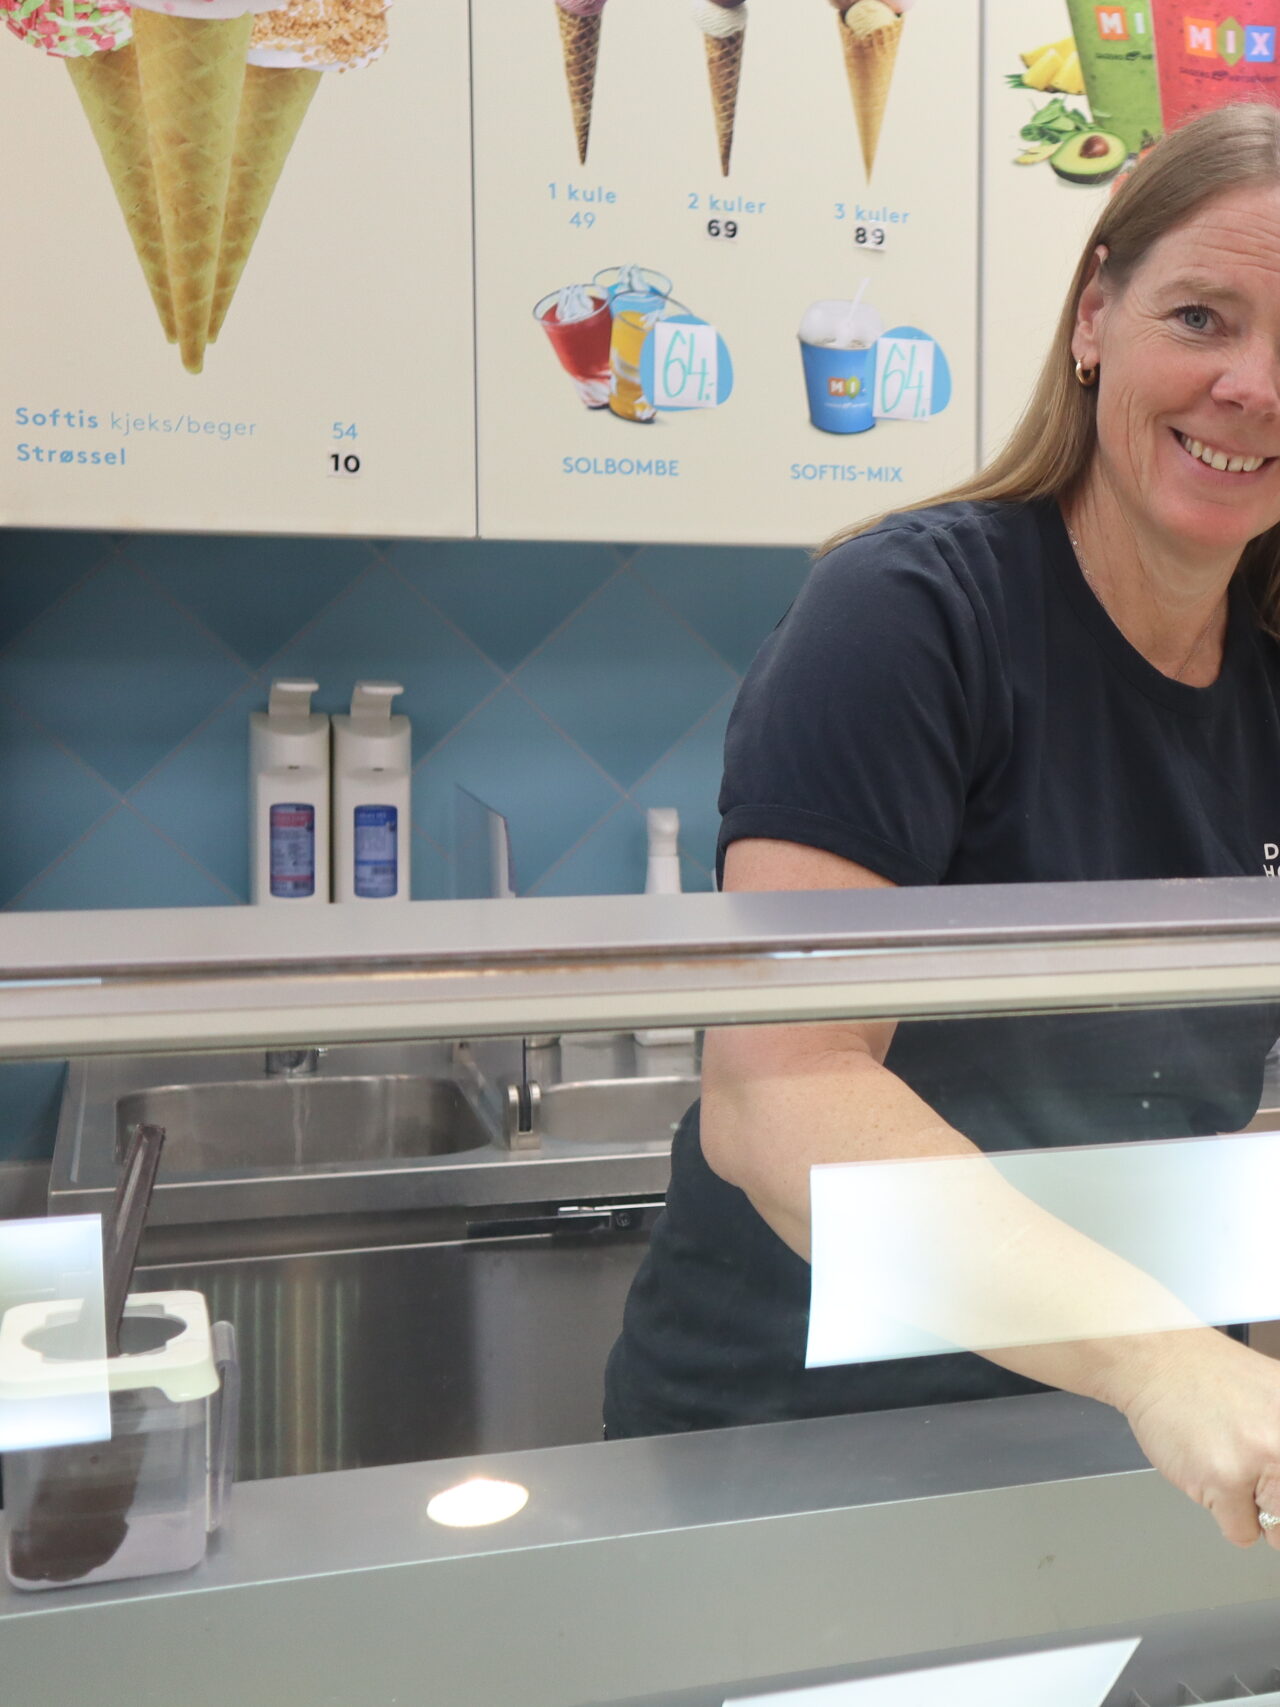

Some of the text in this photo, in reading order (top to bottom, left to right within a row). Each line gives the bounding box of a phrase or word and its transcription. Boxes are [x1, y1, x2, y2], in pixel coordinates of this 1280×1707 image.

[1099, 12, 1146, 34] MI
[1188, 25, 1270, 56] MIX
[548, 182, 618, 205] 1 kule
[688, 193, 767, 215] 2 kuler
[569, 211, 596, 230] 49
[834, 203, 910, 224] 3 kuler
[707, 219, 738, 239] 69
[855, 227, 885, 246] 89
[15, 406, 257, 440] Softis kjeks/beger
[332, 423, 359, 441] 54
[16, 443, 127, 466] Strøssel
[330, 453, 360, 474] 10
[563, 457, 679, 477] SOLBOMBE
[790, 464, 903, 483] SOFTIS-MIX
